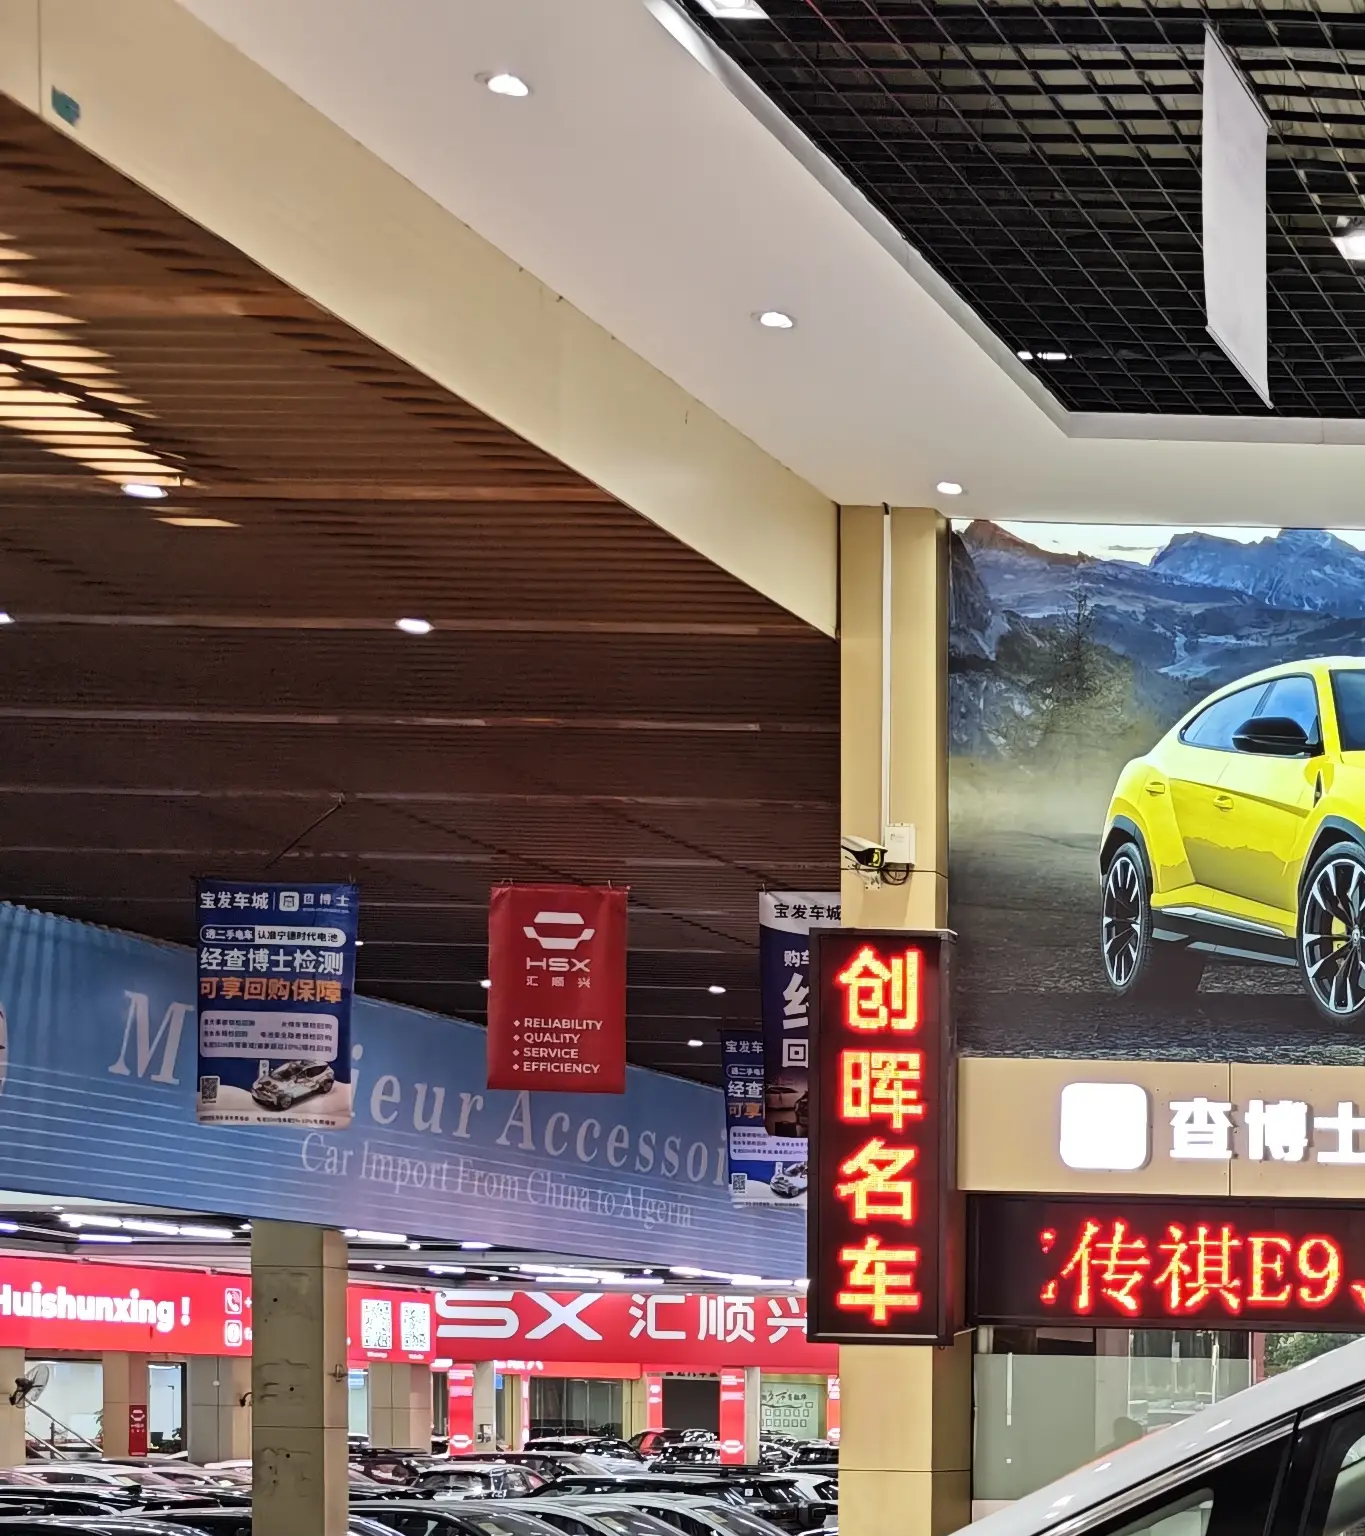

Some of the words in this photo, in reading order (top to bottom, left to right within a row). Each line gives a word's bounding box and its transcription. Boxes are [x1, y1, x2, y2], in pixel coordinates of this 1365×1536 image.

[200, 891, 269, 910] 宝发车城
[774, 903, 841, 921] 宝发车城
[200, 947, 344, 976] 经查博士检测
[526, 957, 591, 973] HSX
[200, 976, 343, 1004] 可享回购保障
[526, 976, 591, 989] 汇顺兴
[524, 1018, 603, 1031] RELIABILITY
[523, 1032, 581, 1044] QUALITY
[523, 1047, 579, 1059] SERVICE
[522, 1061, 601, 1074] EFFICIENCY
[727, 1080, 763, 1099] 经查
[728, 1102, 766, 1120] 可享
[835, 943, 925, 1325] 创晖名车
[301, 1131, 354, 1177] Car
[359, 1143, 452, 1197] Import
[457, 1156, 523, 1197] From
[526, 1165, 591, 1215] China
[621, 1184, 694, 1230] Algeria
[628, 1292, 808, 1344] 汇顺兴
